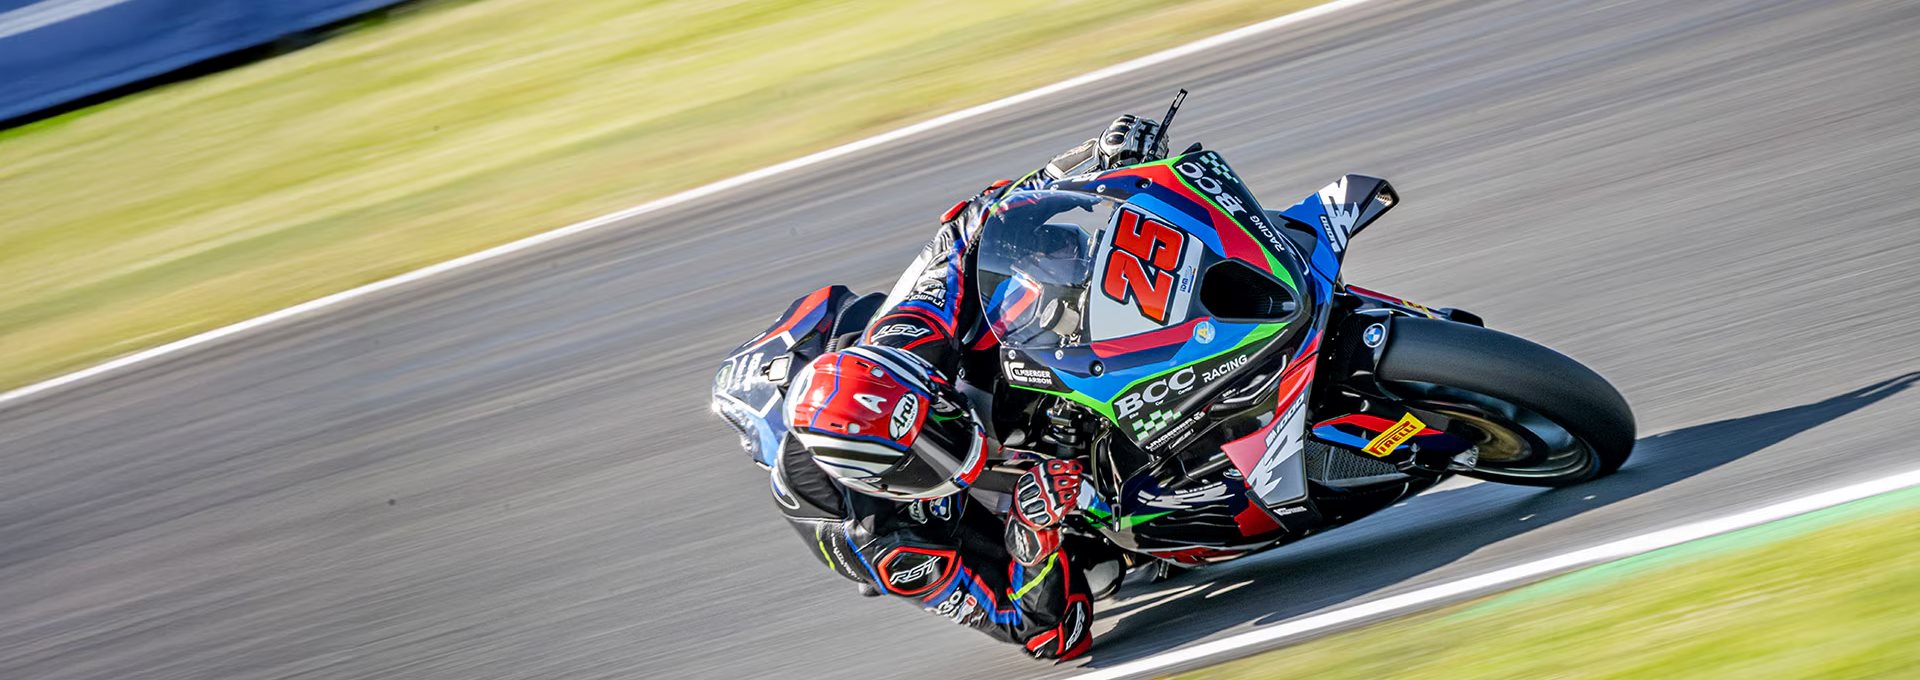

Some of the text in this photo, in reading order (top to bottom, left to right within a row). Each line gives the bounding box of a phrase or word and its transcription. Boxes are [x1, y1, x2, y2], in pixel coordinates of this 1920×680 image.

[1175, 162, 1285, 252] BCC RACING
[1101, 207, 1187, 326] 25
[870, 323, 930, 342] RST
[1113, 354, 1249, 420] BCC RACING
[893, 395, 916, 440] Arai
[1369, 420, 1417, 455] PIRELLI
[890, 555, 941, 585] RST
